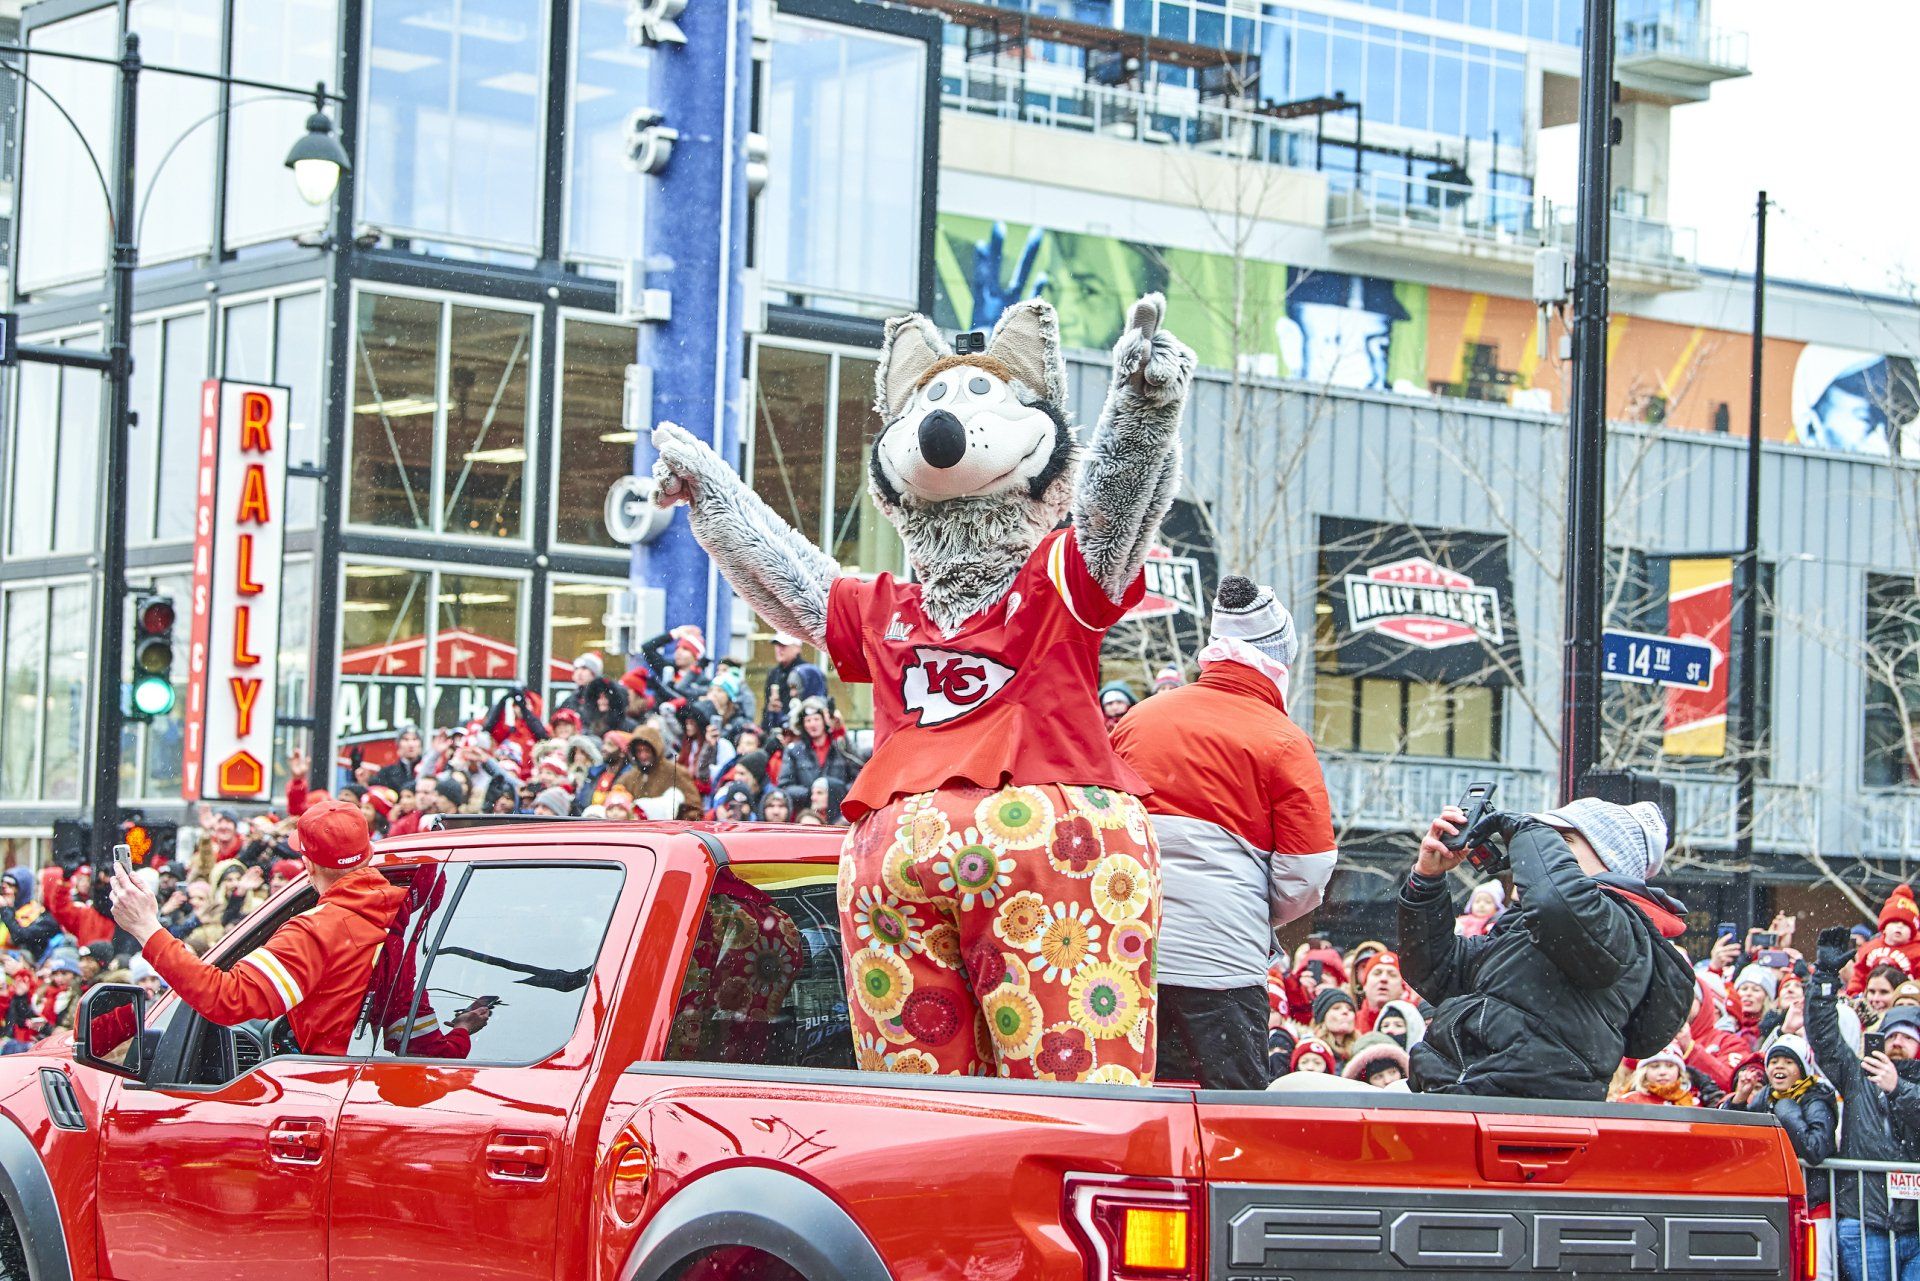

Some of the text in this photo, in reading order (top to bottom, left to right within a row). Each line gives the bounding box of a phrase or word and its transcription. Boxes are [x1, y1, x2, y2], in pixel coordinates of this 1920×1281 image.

[185, 387, 216, 791] KANSAS CITY
[229, 391, 273, 740] RALLY
[1144, 562, 1192, 603] USE
[1353, 583, 1491, 630] RALLY HOUSE
[923, 657, 989, 706] KC
[1607, 642, 1702, 681] E 14TH ST
[338, 682, 444, 737] ALLY
[337, 853, 363, 865] CHIEFS
[1228, 1203, 1782, 1275] FORD
